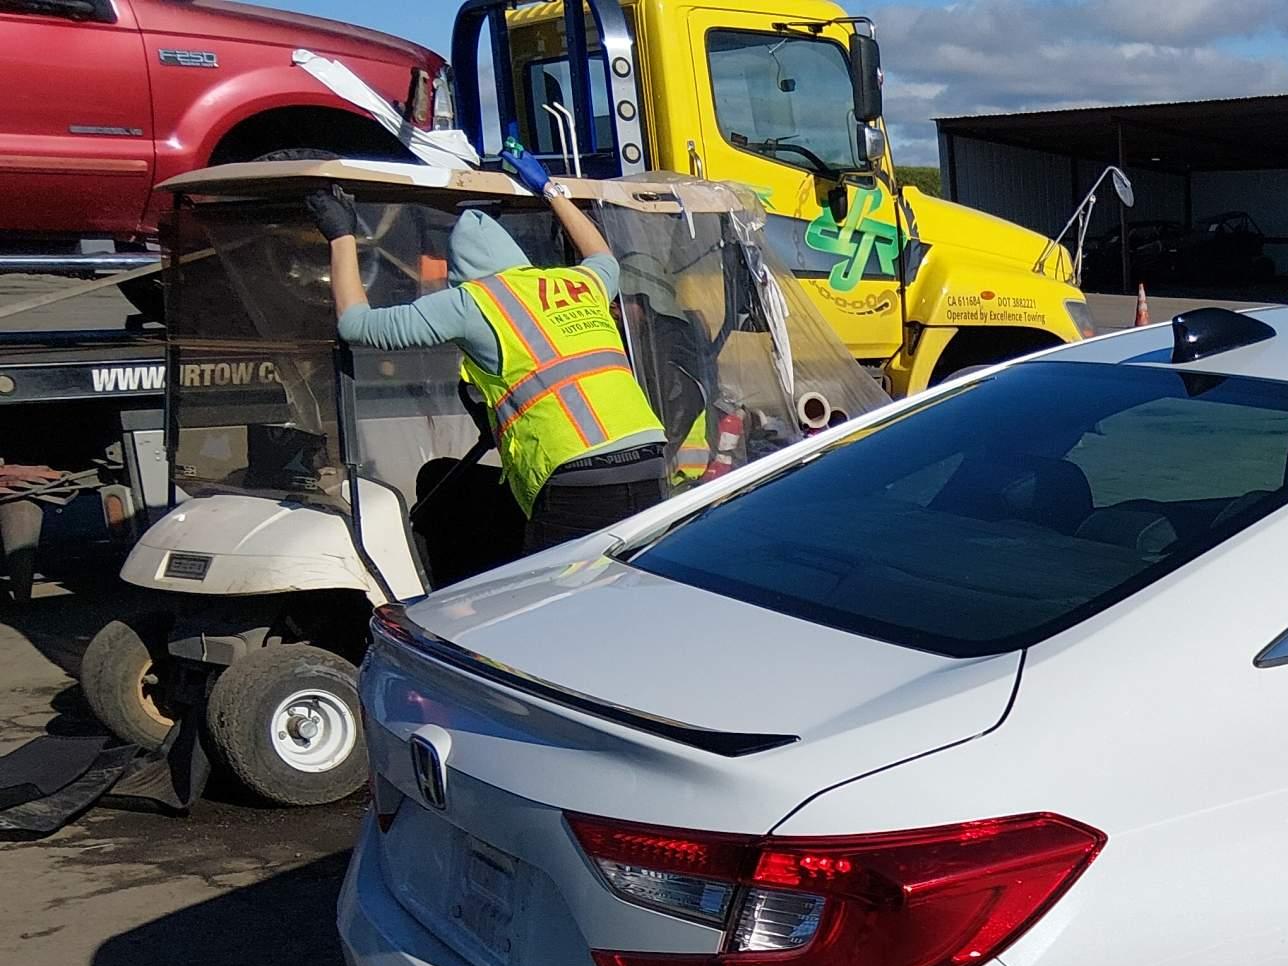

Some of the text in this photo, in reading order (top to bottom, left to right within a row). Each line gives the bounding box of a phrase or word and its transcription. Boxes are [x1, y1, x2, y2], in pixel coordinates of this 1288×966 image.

[947, 296, 957, 307] CA
[997, 297, 1011, 307] DOT
[946, 309, 1046, 325] Operated by Excellence Towing
